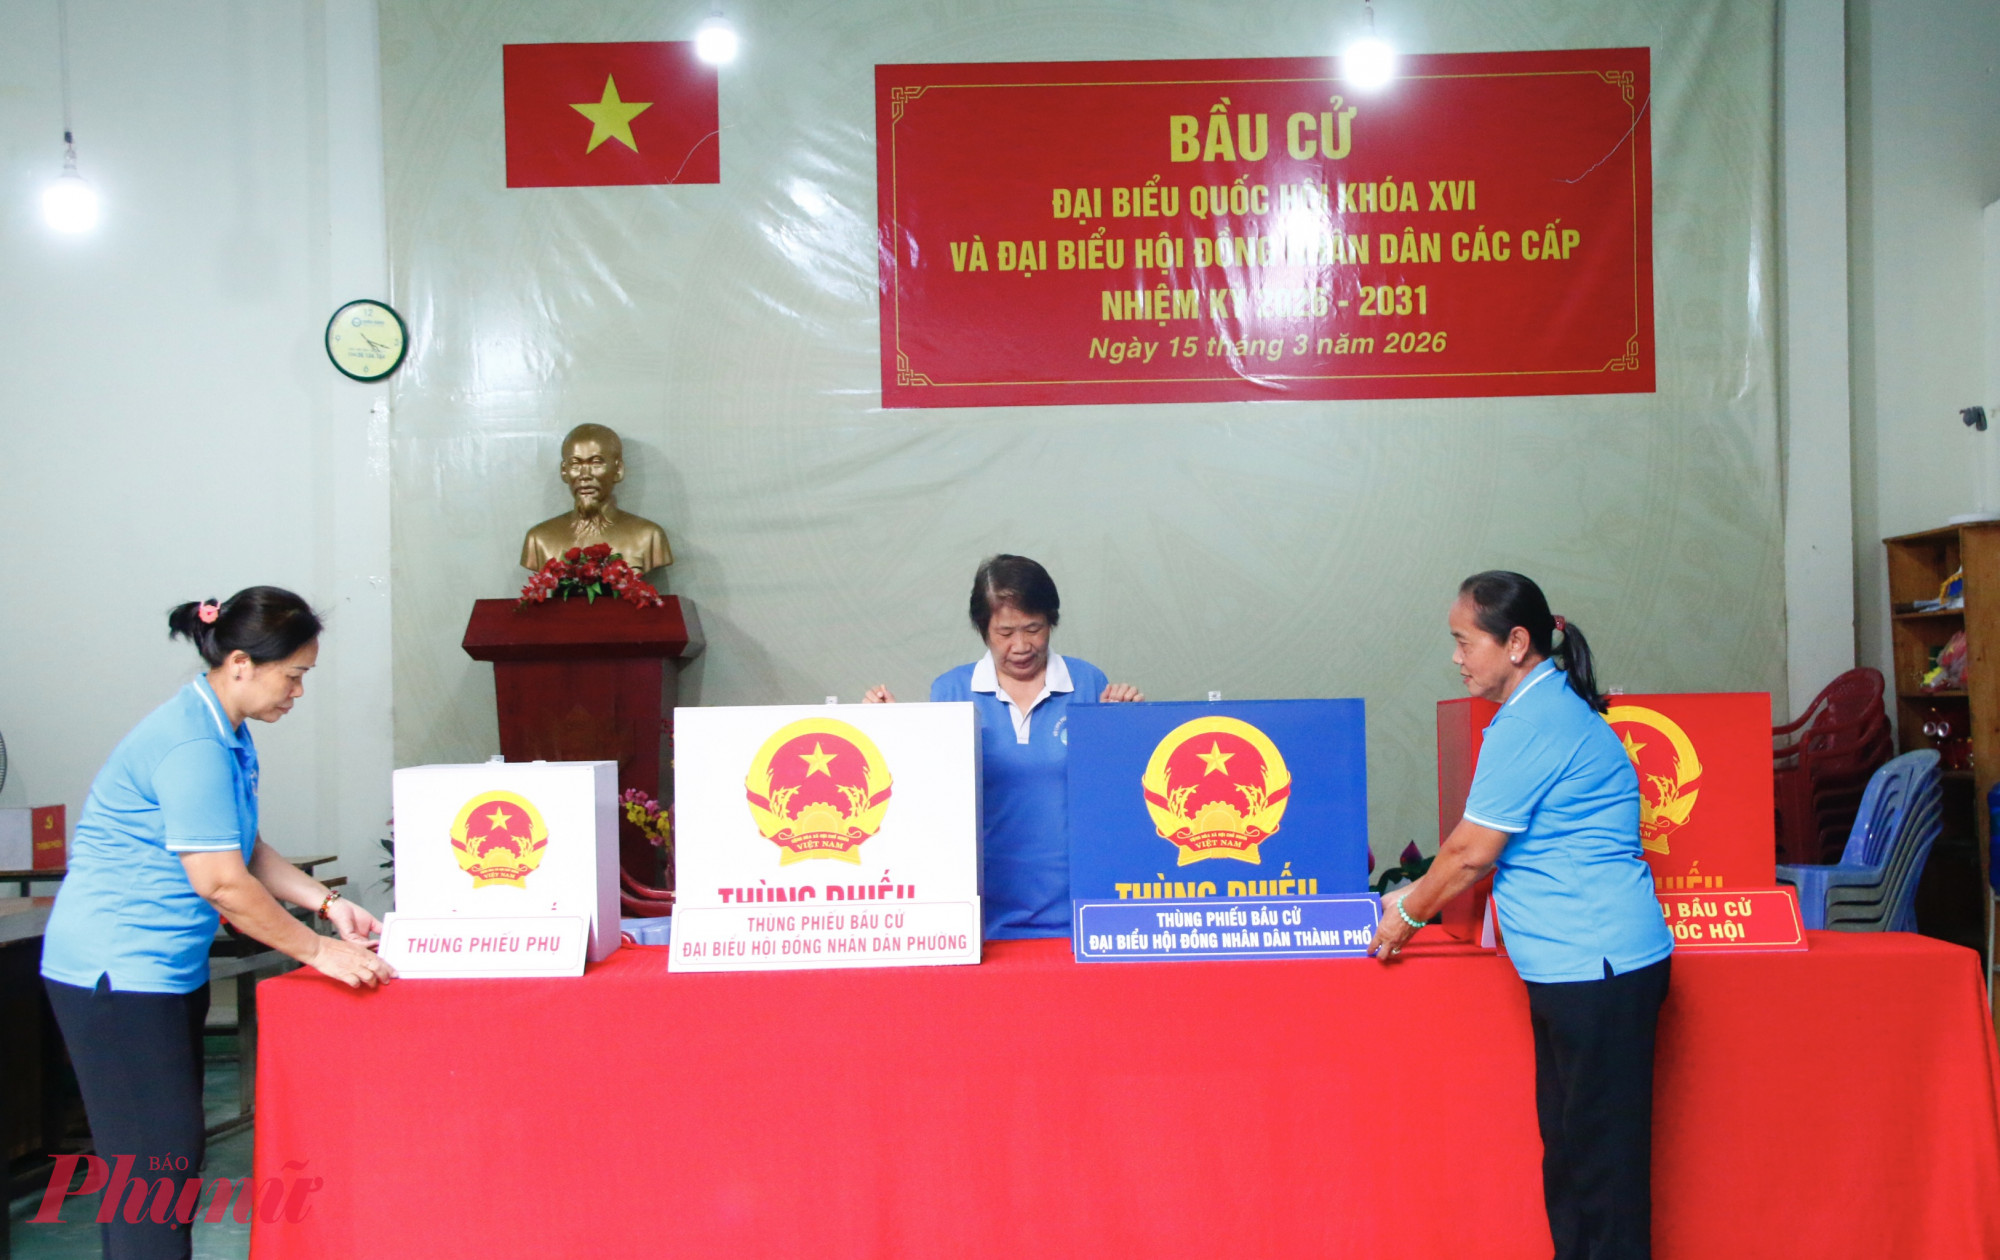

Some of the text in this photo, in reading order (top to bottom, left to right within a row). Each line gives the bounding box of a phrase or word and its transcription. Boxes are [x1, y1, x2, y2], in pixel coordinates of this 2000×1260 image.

[1169, 95, 1358, 162] BẦU CỬ
[1052, 187, 1102, 225] ĐẠI
[1112, 174, 1180, 218] BIỂU
[1189, 174, 1269, 220] QUỐC
[1337, 175, 1419, 214] KHÓA
[1428, 180, 1476, 212] XVI
[950, 235, 989, 272] VÀ
[997, 240, 1047, 278] ĐẠI
[1057, 227, 1125, 270] BIỂU
[1135, 231, 1184, 275] HỘI
[1193, 227, 1273, 269] ĐỒNG
[1379, 226, 1441, 264] DÂN
[1451, 225, 1511, 262] CÁC
[1521, 218, 1581, 261] CẤP
[1102, 283, 1199, 327] NHIỆM
[1209, 282, 1247, 319] KỲ
[1256, 287, 1329, 318] 2026
[1358, 285, 1427, 316] 2031
[1088, 331, 1448, 364] Ngày 15 tháng 3 năm 2026
[822, 840, 844, 850] NAM
[1220, 838, 1242, 848] NAM
[1156, 905, 1302, 928] THÙNG PHIẾU BẦU CỬ
[1677, 897, 1718, 917] BẦU
[1724, 896, 1752, 917] CỬ
[747, 908, 906, 933] THÙNG PHIẾU BẦU CỬ
[1708, 919, 1746, 942] HỘI
[407, 931, 561, 955] THÙNG PHIẾU PHỤ
[682, 931, 967, 960] ĐẠI BIỂU HỘI ĐỒNG NHÂN DÂN PHƯỜNG
[1089, 924, 1372, 953] ĐẠI BIỂU HỘI ĐỒNG NHÂN DÂN THÀNH PHỐ
